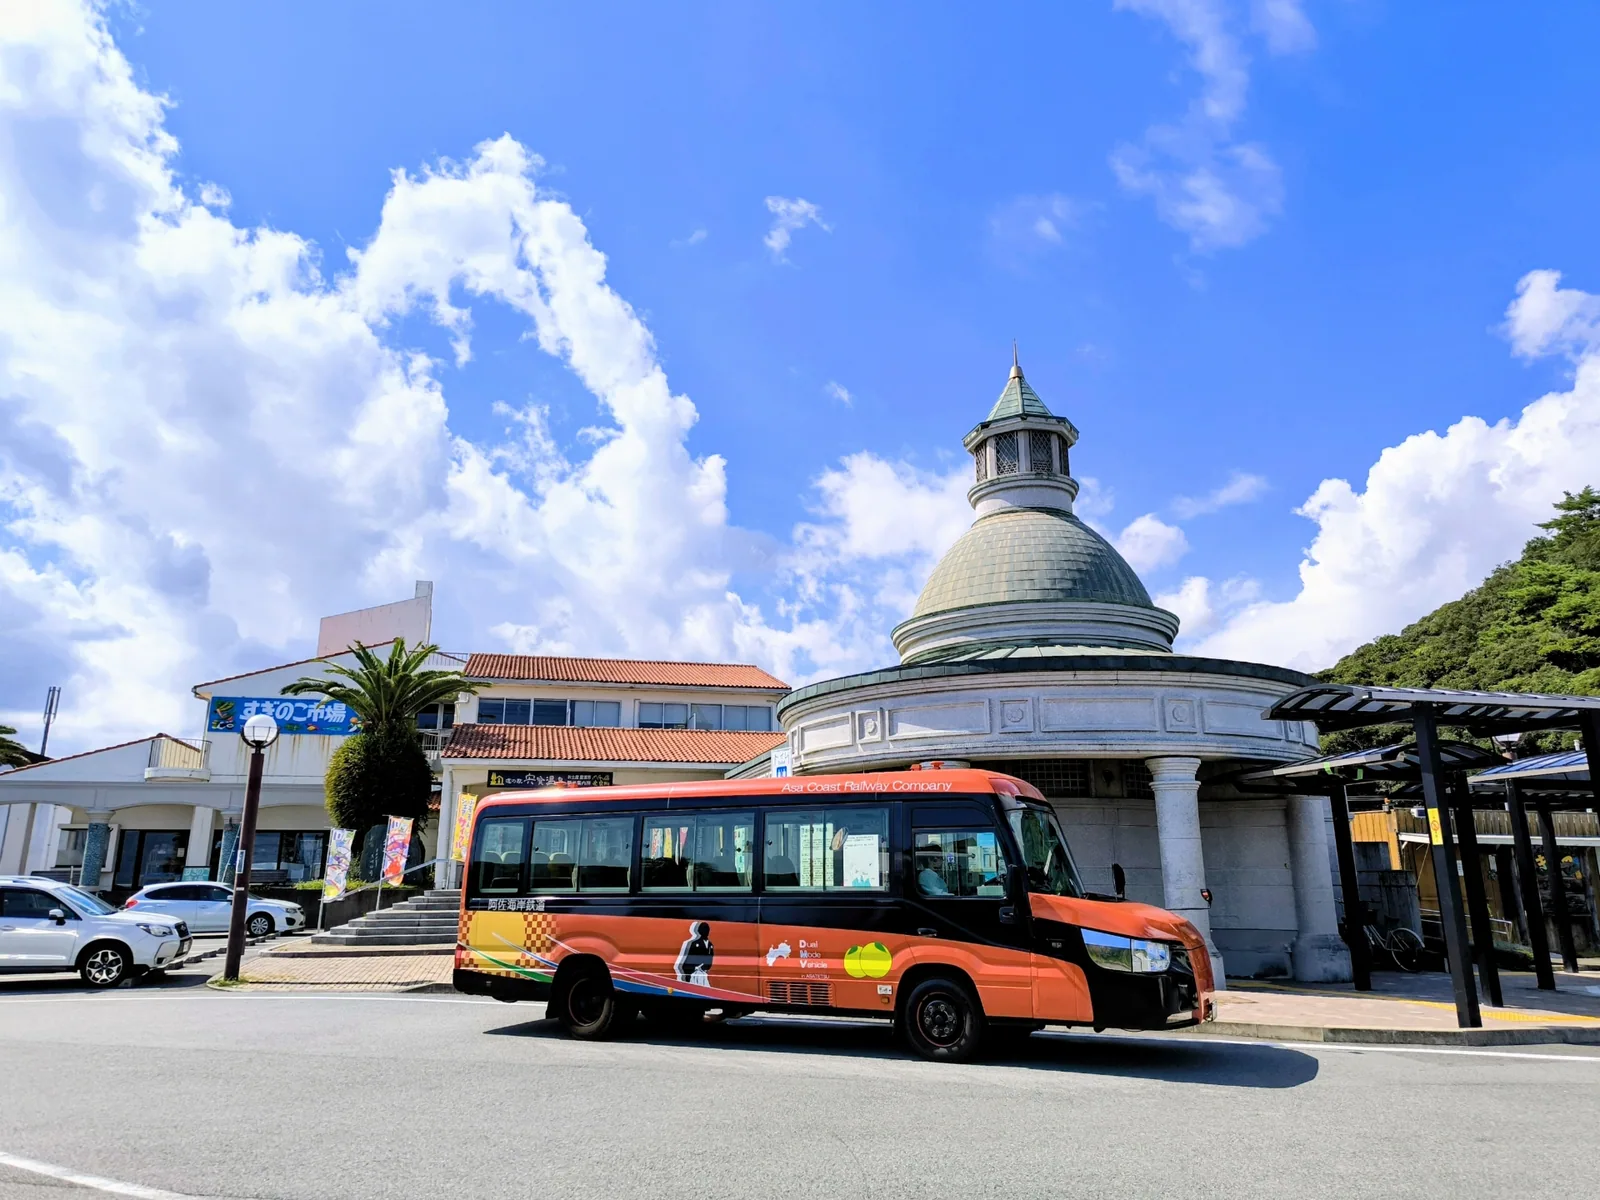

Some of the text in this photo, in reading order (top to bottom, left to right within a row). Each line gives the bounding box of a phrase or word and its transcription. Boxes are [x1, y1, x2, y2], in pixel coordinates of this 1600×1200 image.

[239, 700, 347, 723] すぎのこ市場
[782, 780, 953, 792] Asa Coast Railway Company
[488, 899, 546, 911] 阿佐海岸鉄道
[799, 940, 818, 948] Dual
[800, 960, 828, 968] Vehicle
